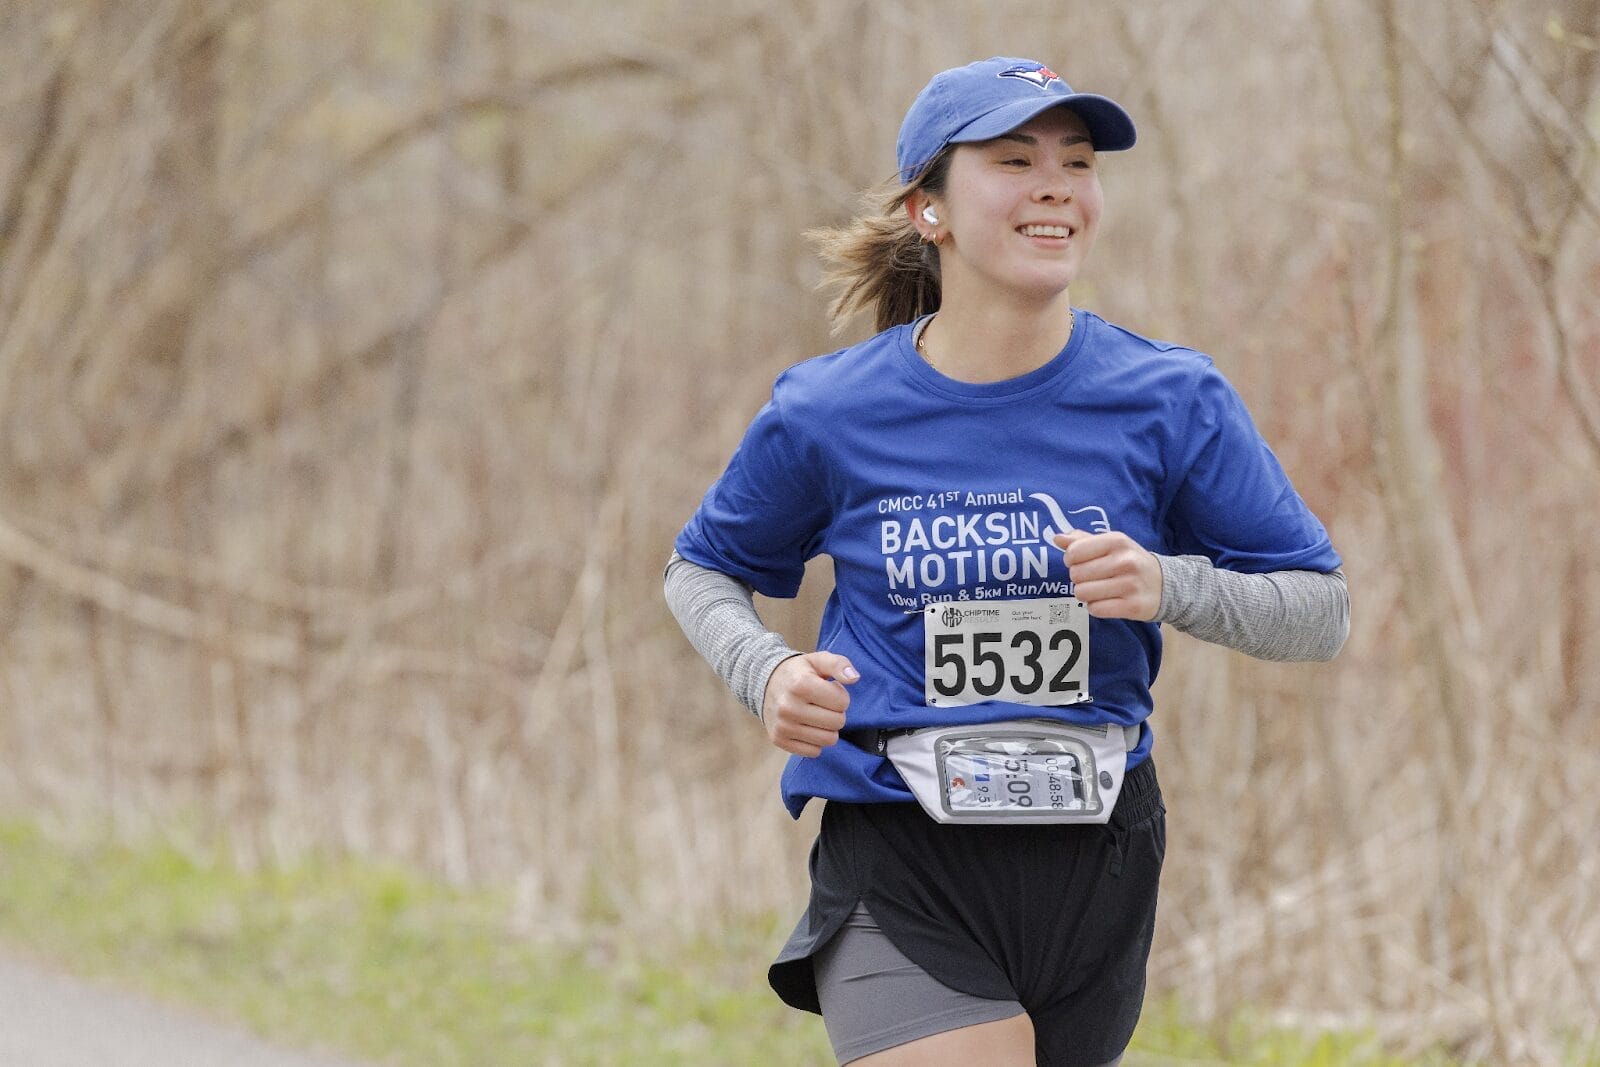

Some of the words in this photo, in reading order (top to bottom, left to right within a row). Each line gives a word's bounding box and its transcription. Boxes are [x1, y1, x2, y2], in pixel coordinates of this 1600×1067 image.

[878, 495, 923, 514] CMCC
[926, 491, 960, 510] 41ST
[964, 488, 1024, 507] Annual
[885, 546, 1048, 590] MOTION
[921, 592, 953, 604] Run
[958, 589, 970, 601] &
[1006, 581, 1076, 598] Run/Wal
[964, 609, 1000, 617] CHIPTIME
[933, 629, 1082, 697] 5532
